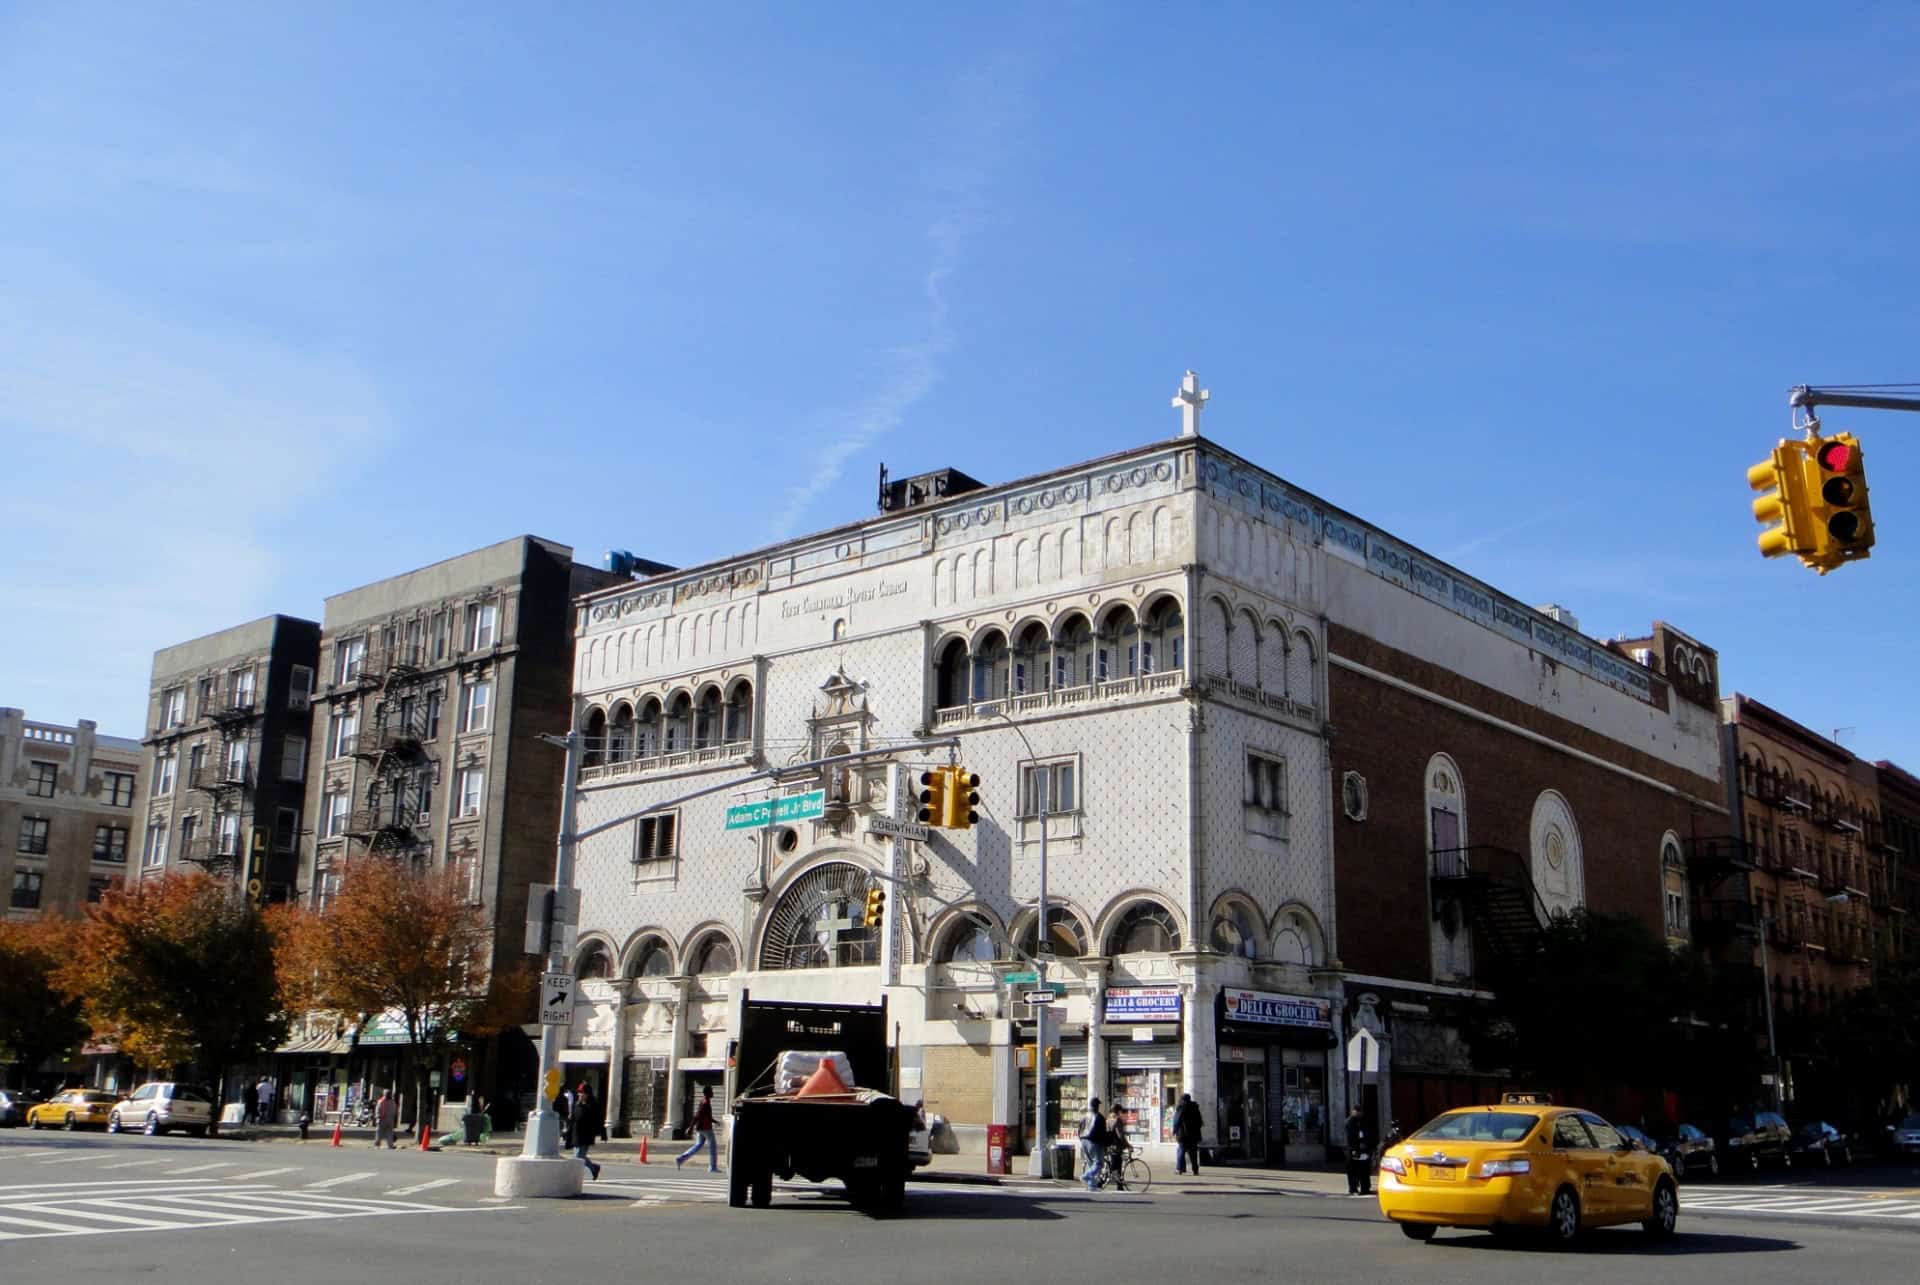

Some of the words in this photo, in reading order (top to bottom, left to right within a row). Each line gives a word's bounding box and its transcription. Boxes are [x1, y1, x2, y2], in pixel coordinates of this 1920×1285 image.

[728, 810, 752, 825] Adam
[753, 809, 760, 820] C
[802, 798, 821, 812] Blvd
[871, 820, 926, 837] CORINTHIAN
[248, 833, 264, 911] LIQ
[547, 977, 571, 988] KEEP
[1107, 997, 1127, 1007] DELI
[1136, 997, 1177, 1007] GROCERY
[1240, 999, 1263, 1015] DELI
[1265, 1003, 1272, 1016] &
[1275, 1003, 1317, 1020] GROCERY
[544, 1011, 571, 1022] RIGHT
